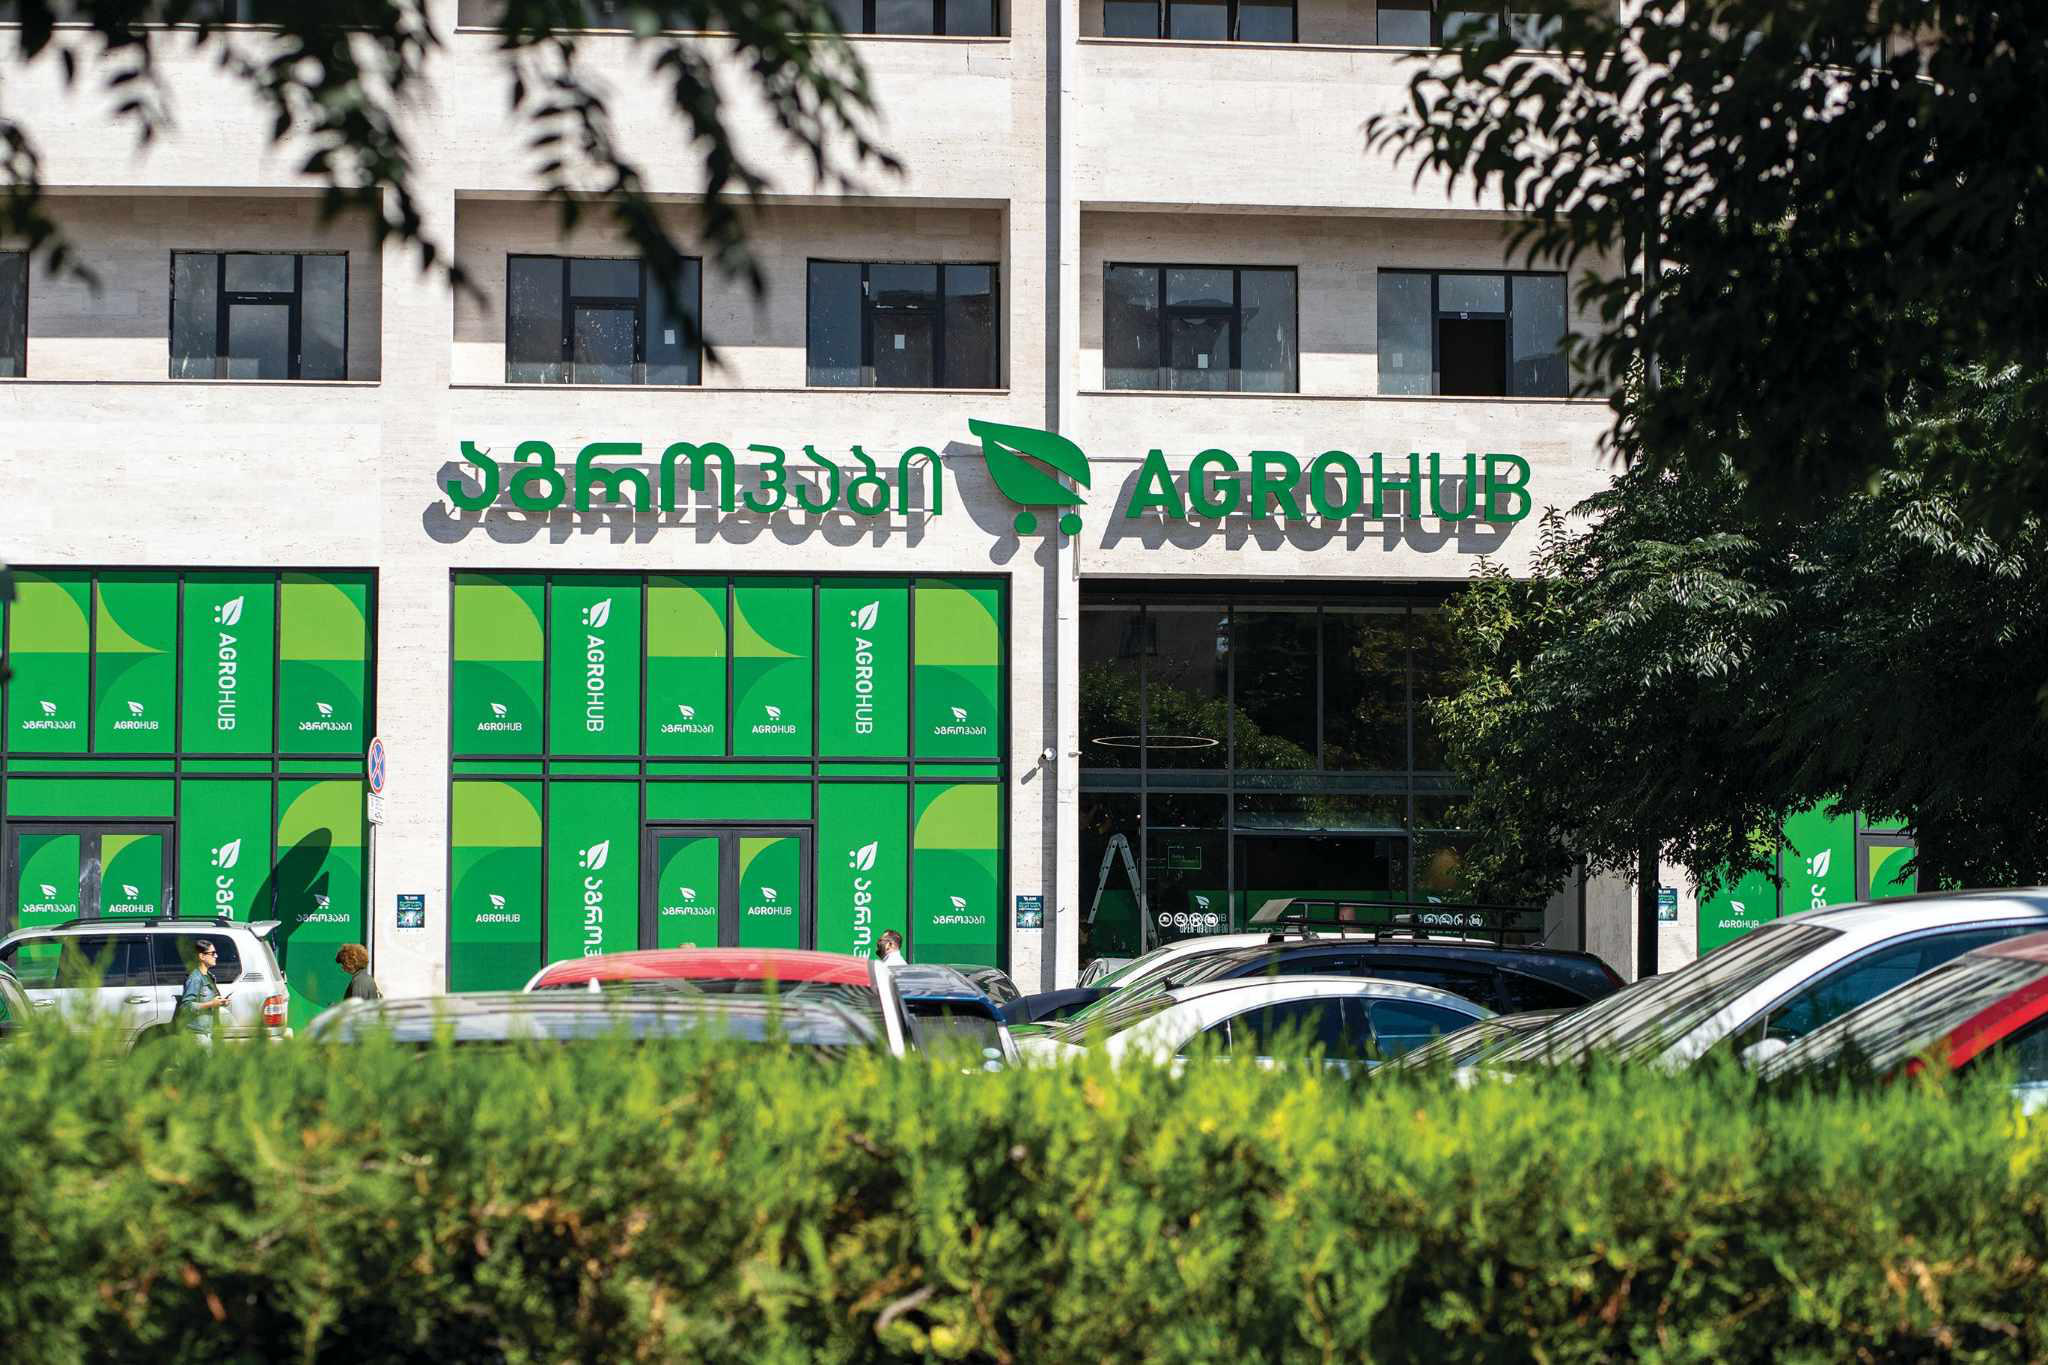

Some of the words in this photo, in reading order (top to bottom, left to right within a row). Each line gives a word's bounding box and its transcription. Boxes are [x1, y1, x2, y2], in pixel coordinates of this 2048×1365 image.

[448, 441, 943, 515] აგროჰაბი
[1125, 449, 1531, 522] AGROHUB
[218, 633, 236, 729] AGROHUB
[587, 636, 604, 731] AGROHUB
[856, 638, 872, 733] AGROHUB
[23, 721, 75, 729] აგროჰაბი
[114, 721, 158, 730] AGROHUB
[299, 722, 352, 731] აგროჰაბი
[478, 723, 521, 731] AGROHUB
[662, 725, 713, 733] აგროჰაბი
[752, 725, 795, 734] AGROHUB
[935, 727, 985, 735] აგროჰაბი
[23, 904, 75, 913] აგროჰაბი
[109, 905, 153, 913] AGROHUB
[663, 907, 714, 916] აგროჰაბი
[748, 907, 791, 915] AGROHUB
[296, 914, 350, 922] აგროჰაბი
[476, 914, 520, 923] AGROHUB
[934, 916, 984, 924] აგროჰაბი
[1718, 920, 1760, 929] AGROHUB
